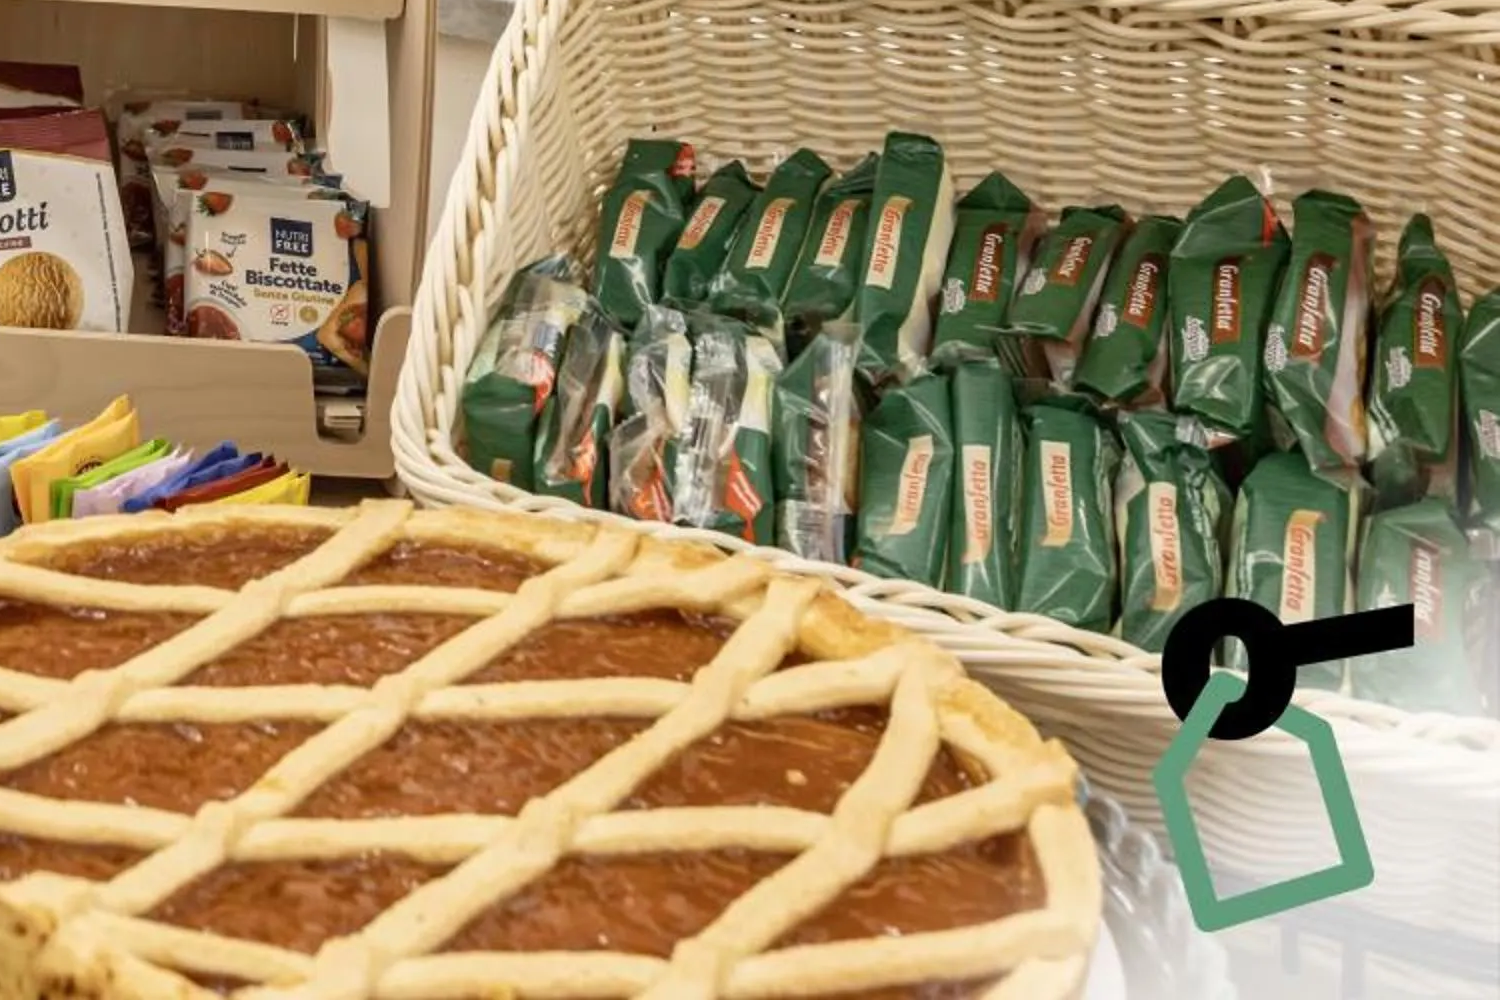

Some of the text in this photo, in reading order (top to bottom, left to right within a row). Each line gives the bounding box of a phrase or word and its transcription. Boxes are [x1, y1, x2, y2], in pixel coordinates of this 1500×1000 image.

[275, 229, 309, 243] NUTRI
[275, 240, 309, 254] FREE
[975, 233, 1003, 294] Granfetta
[245, 269, 343, 295] Biscottate
[269, 257, 317, 277] Fette
[1216, 264, 1240, 330] Granfetta
[1299, 267, 1329, 352] Granfetta
[1047, 455, 1072, 527] Granfetta
[1413, 547, 1435, 625] ranfetta
